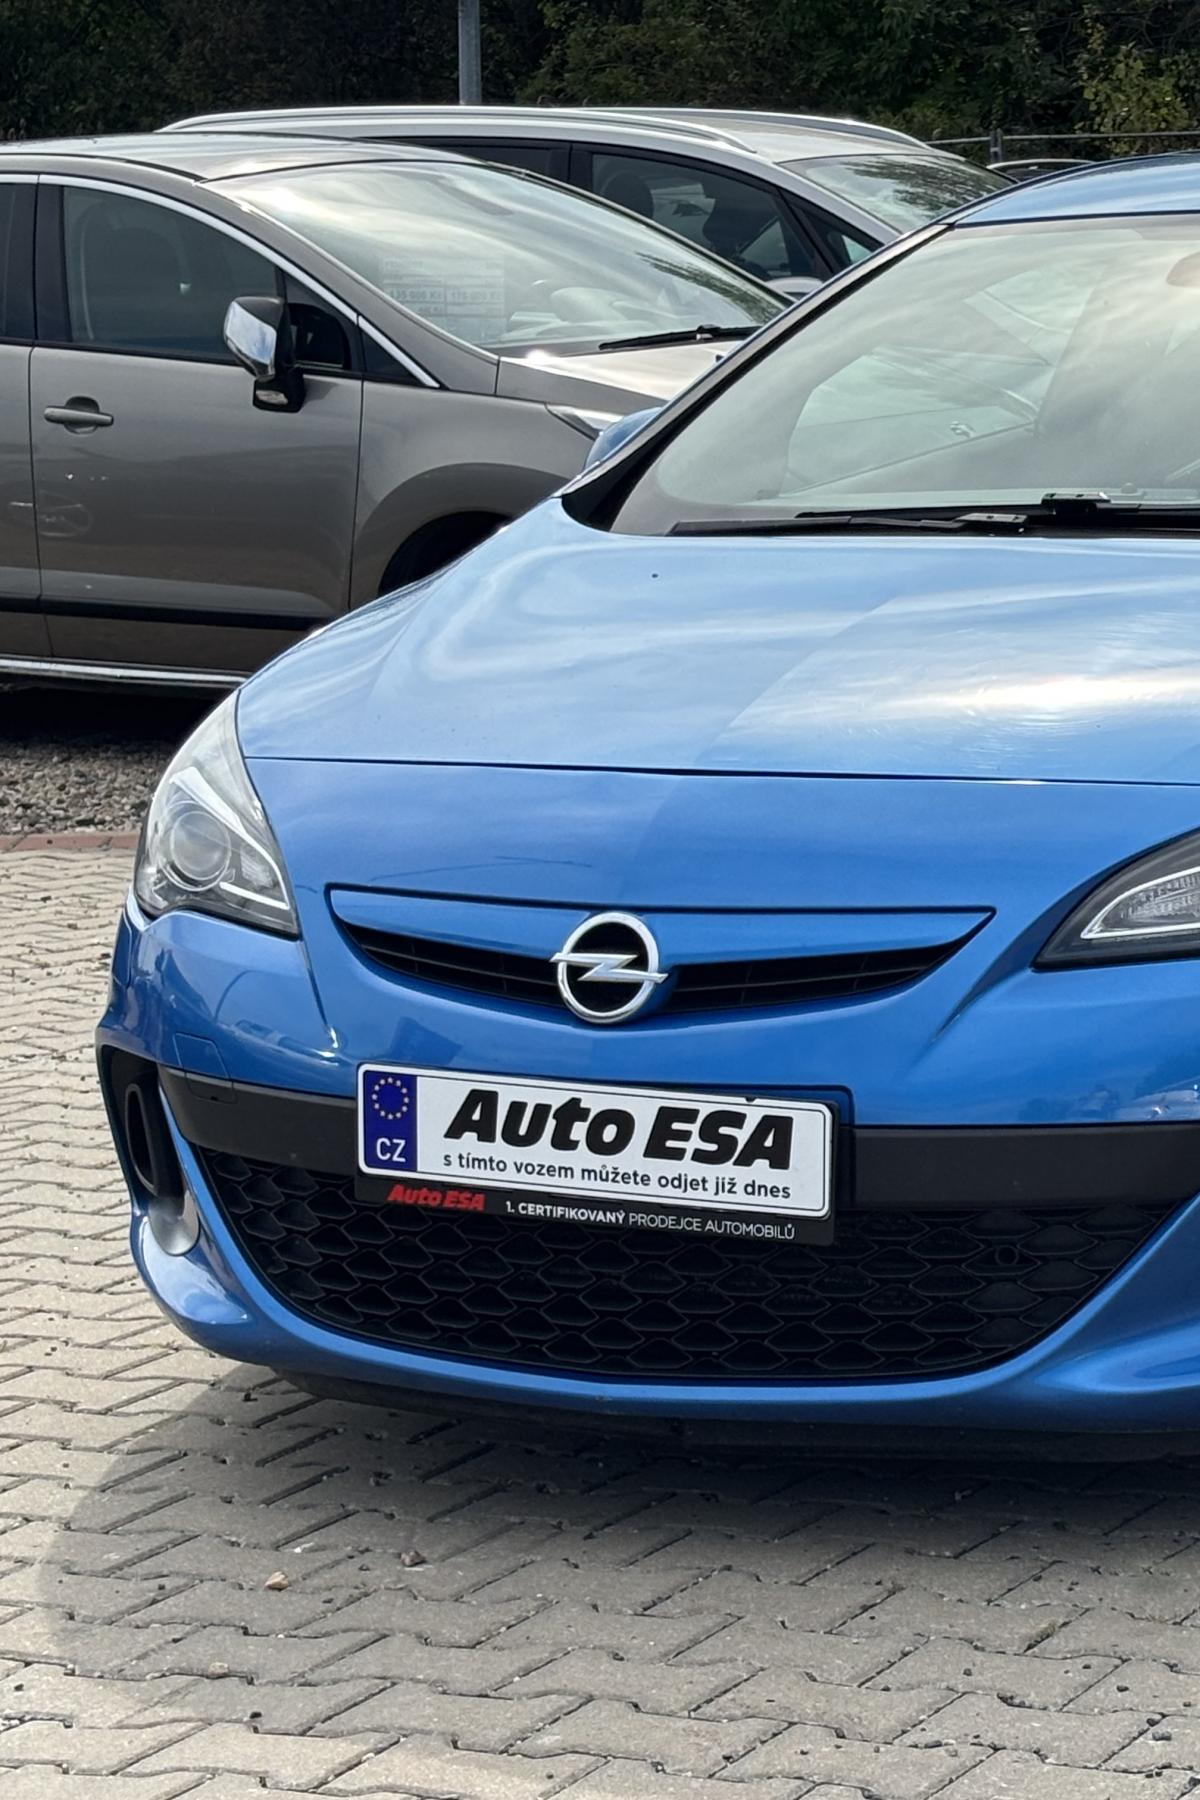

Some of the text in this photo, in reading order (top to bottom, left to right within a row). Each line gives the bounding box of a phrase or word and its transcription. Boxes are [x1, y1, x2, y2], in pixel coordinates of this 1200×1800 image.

[443, 1088, 794, 1170] Auto ESA
[376, 1138, 406, 1162] CZ
[443, 1153, 452, 1167] s
[458, 1152, 507, 1172] tímto
[513, 1161, 574, 1180] vozem
[581, 1164, 651, 1186] můžete
[658, 1173, 708, 1194] odjet
[744, 1180, 791, 1199] dnes
[387, 1183, 486, 1211] Auto ESA
[506, 1200, 795, 1239] 1. CERTIFIKOVANÝ PRODEJCE AUTOMOBILŮ
